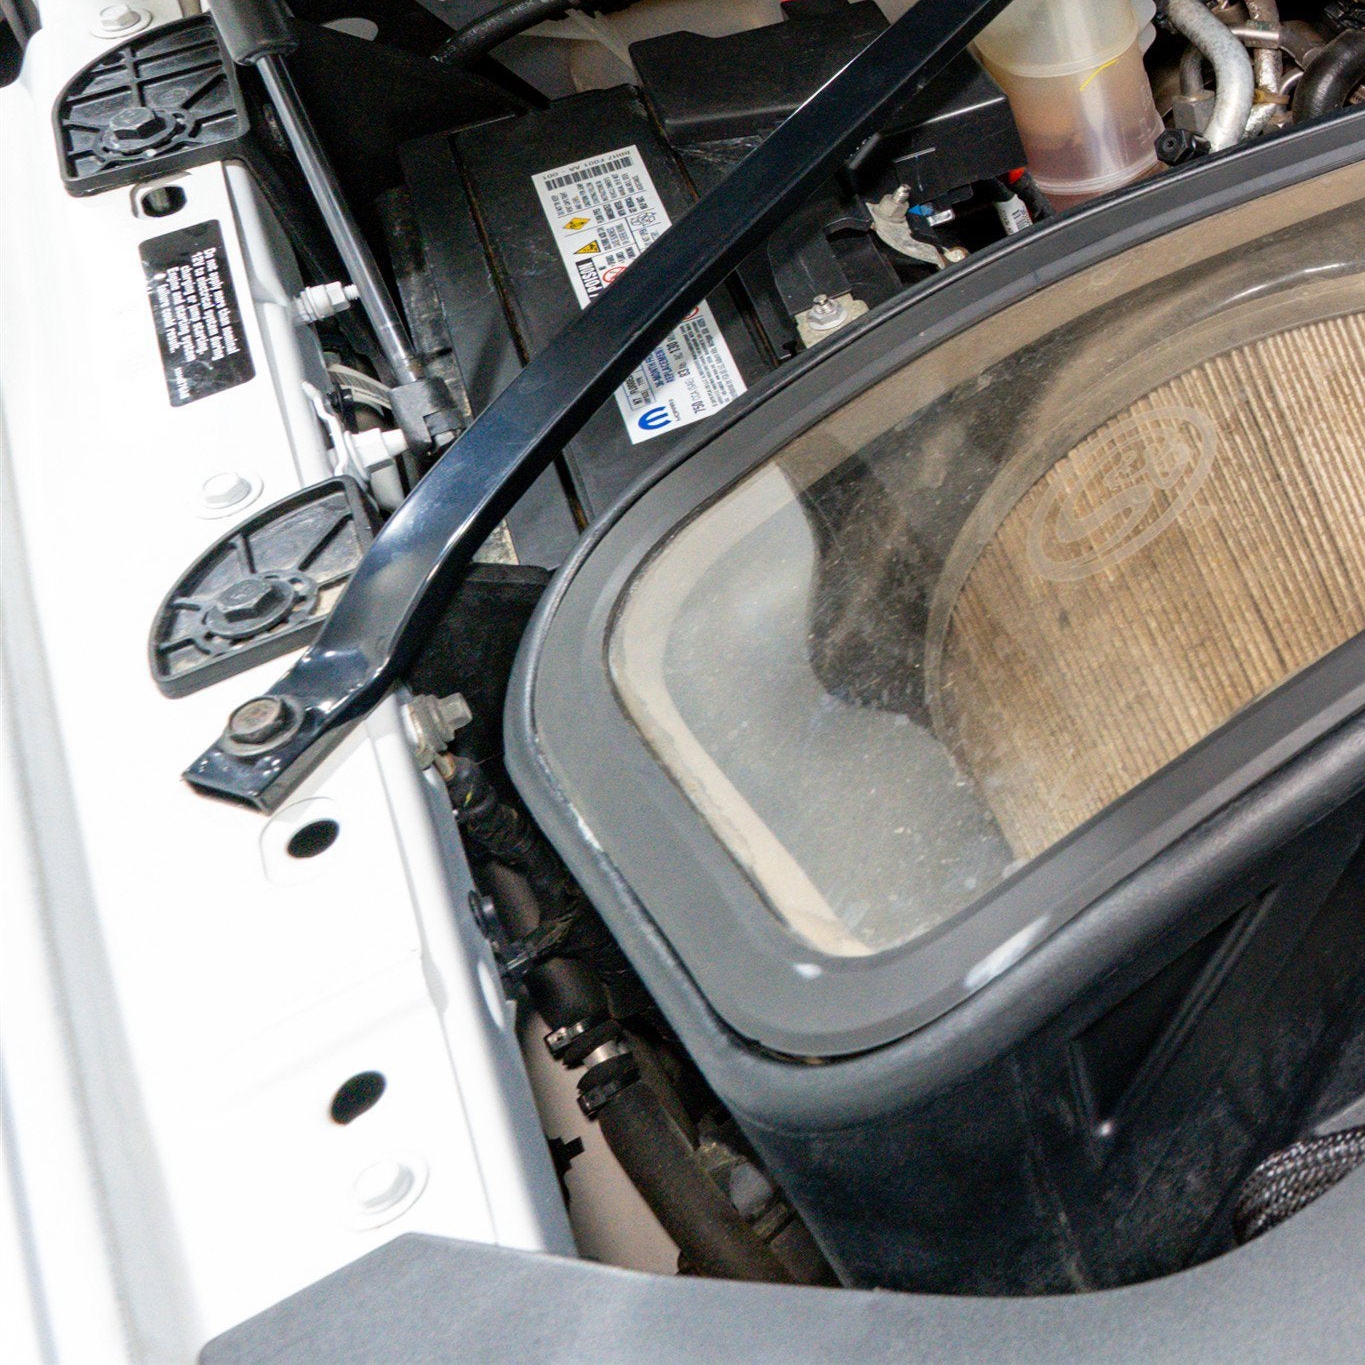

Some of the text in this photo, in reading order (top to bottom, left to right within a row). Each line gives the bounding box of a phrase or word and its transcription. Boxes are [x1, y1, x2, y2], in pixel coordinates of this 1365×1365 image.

[205, 247, 216, 258] Do
[207, 258, 217, 270] not
[165, 266, 181, 291] Engine
[208, 270, 223, 291] apply
[577, 261, 602, 292] POISON
[192, 251, 225, 361] 12V to electrical system during
